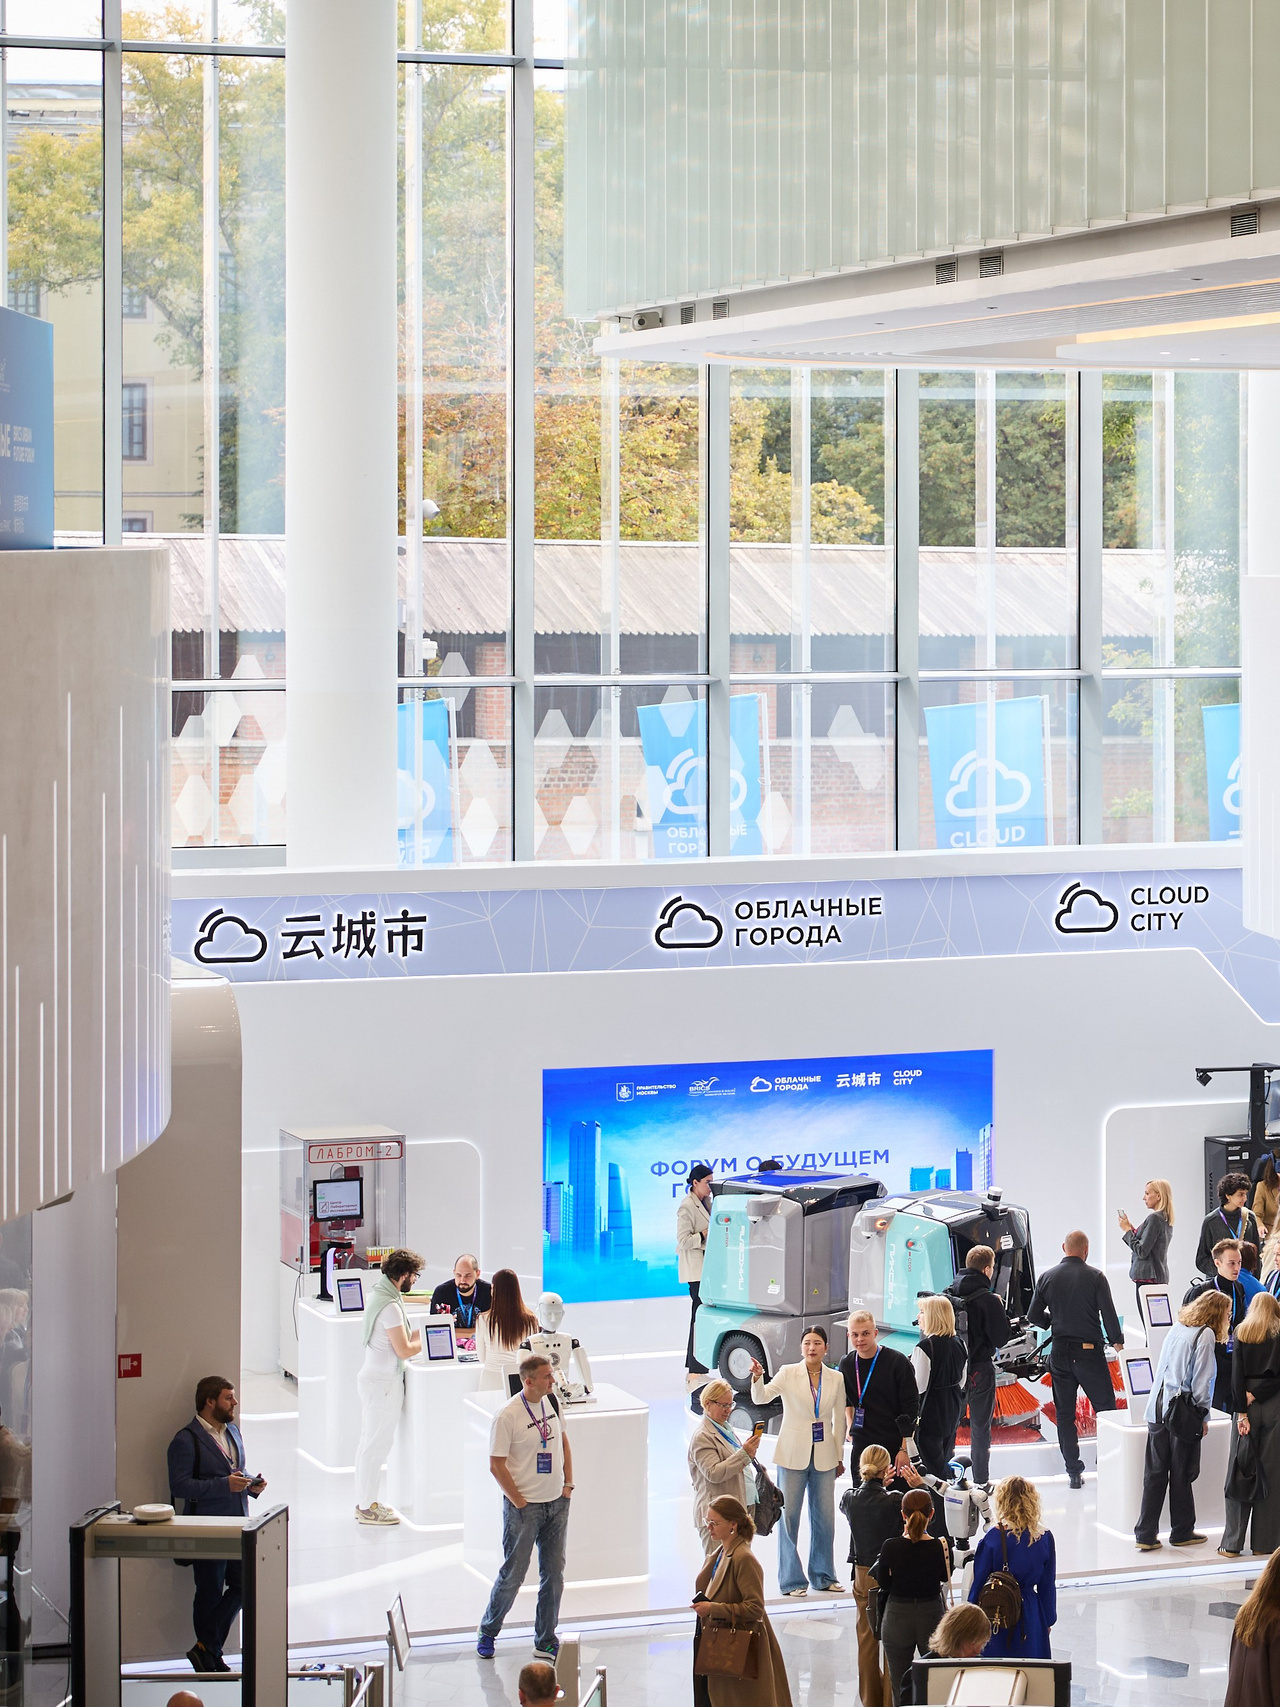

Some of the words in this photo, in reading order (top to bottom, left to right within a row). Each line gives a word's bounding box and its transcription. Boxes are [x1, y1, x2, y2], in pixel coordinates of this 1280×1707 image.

[1130, 885, 1209, 906] CLOUD
[734, 897, 882, 920] ОБЛАЧНЫЕ
[1130, 912, 1184, 932] CITY
[281, 908, 427, 961] 云城市
[735, 924, 842, 948] ГОРОДА
[774, 1076, 822, 1084] ОБЛАЧНЫЕ
[836, 1071, 882, 1088] 云城市
[893, 1069, 923, 1078] CLOUD
[893, 1077, 914, 1086] CITY
[774, 1083, 809, 1092] ГОРОДА
[771, 1149, 889, 1171] БУДУЩЕМ
